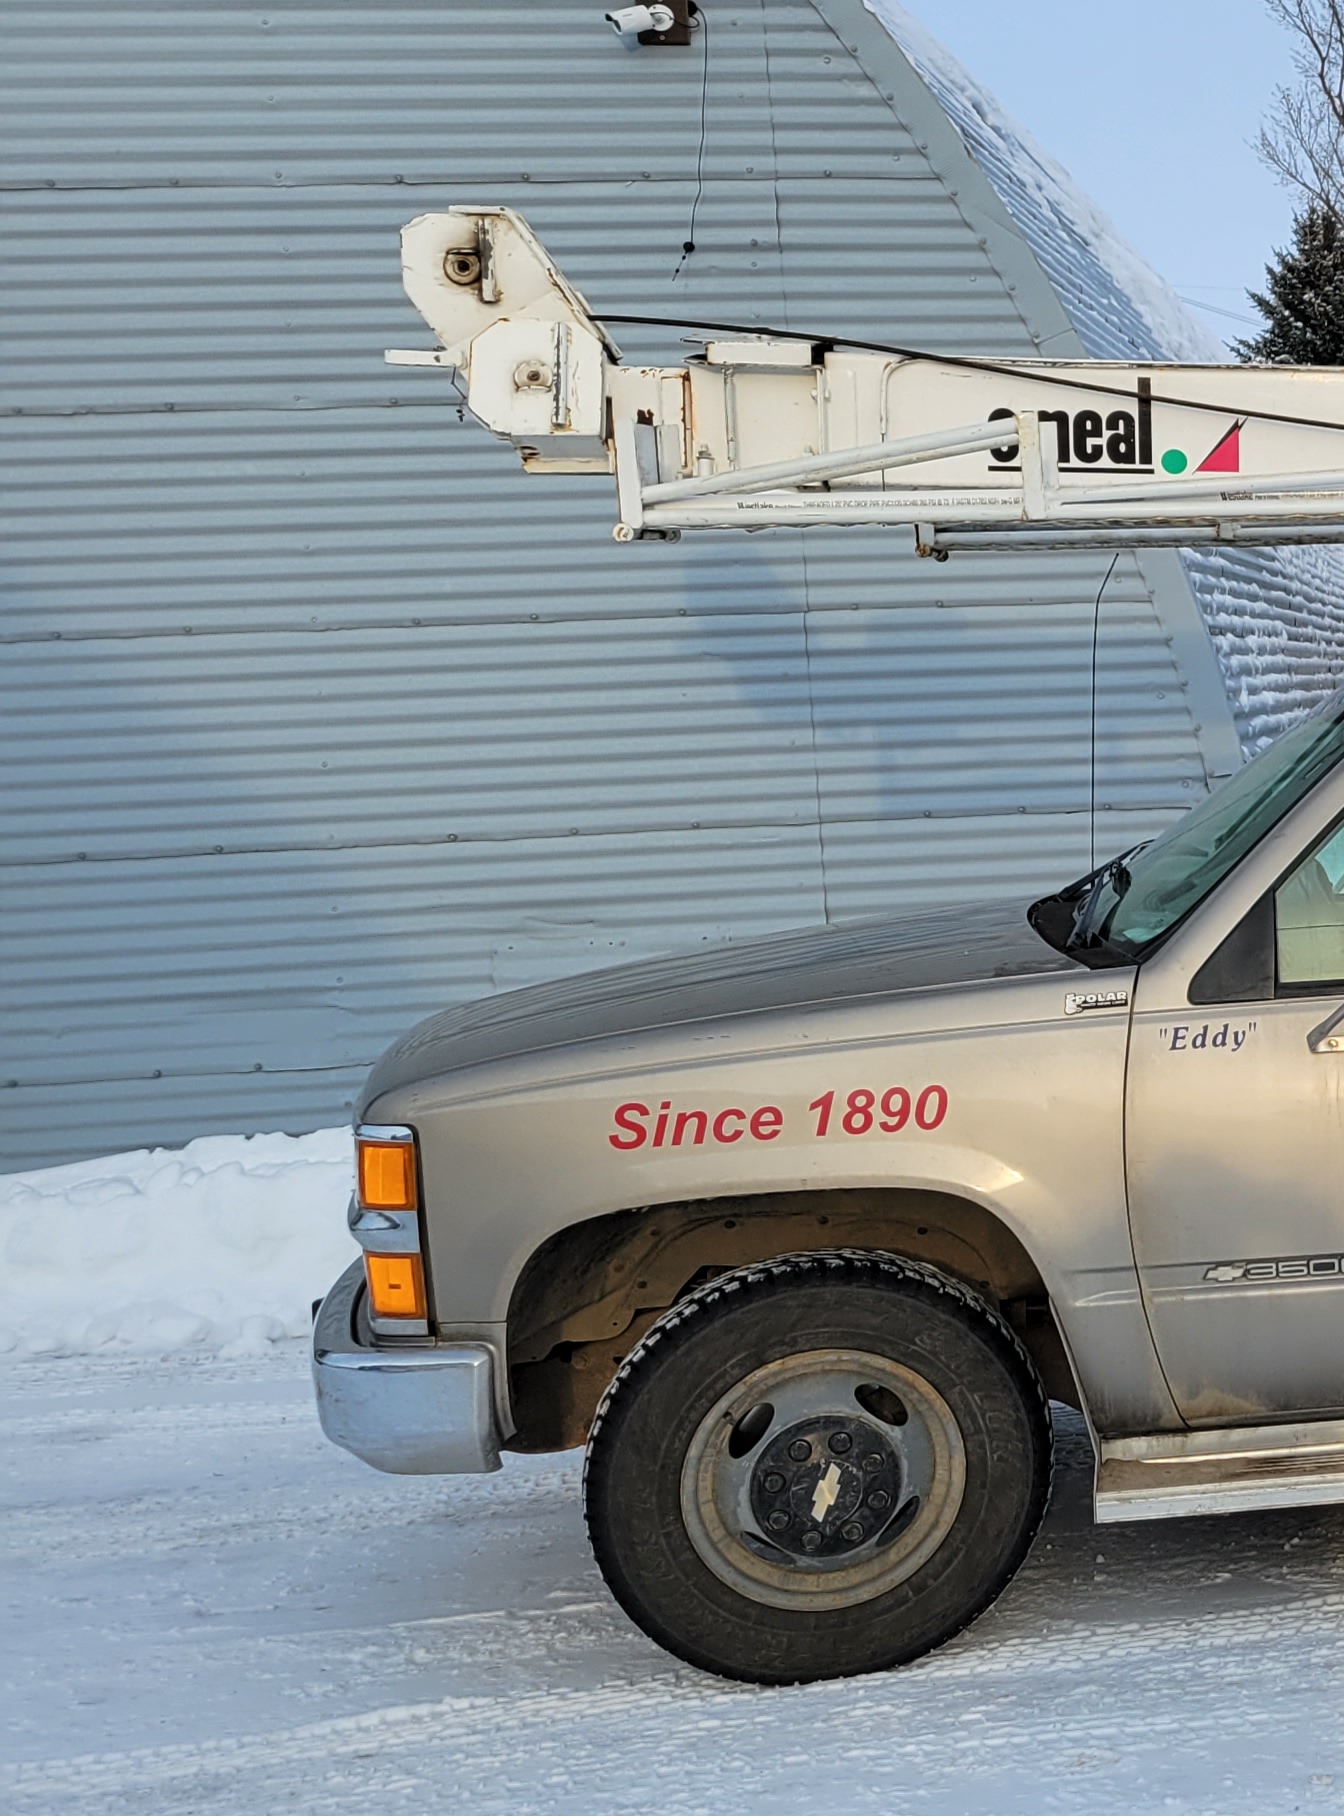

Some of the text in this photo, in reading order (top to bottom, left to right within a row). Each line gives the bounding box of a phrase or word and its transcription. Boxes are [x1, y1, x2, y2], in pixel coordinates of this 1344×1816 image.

[1075, 991, 1127, 1005] POLAR
[1159, 1022, 1257, 1052] "Eddy"
[608, 1085, 949, 1150] Since 1890
